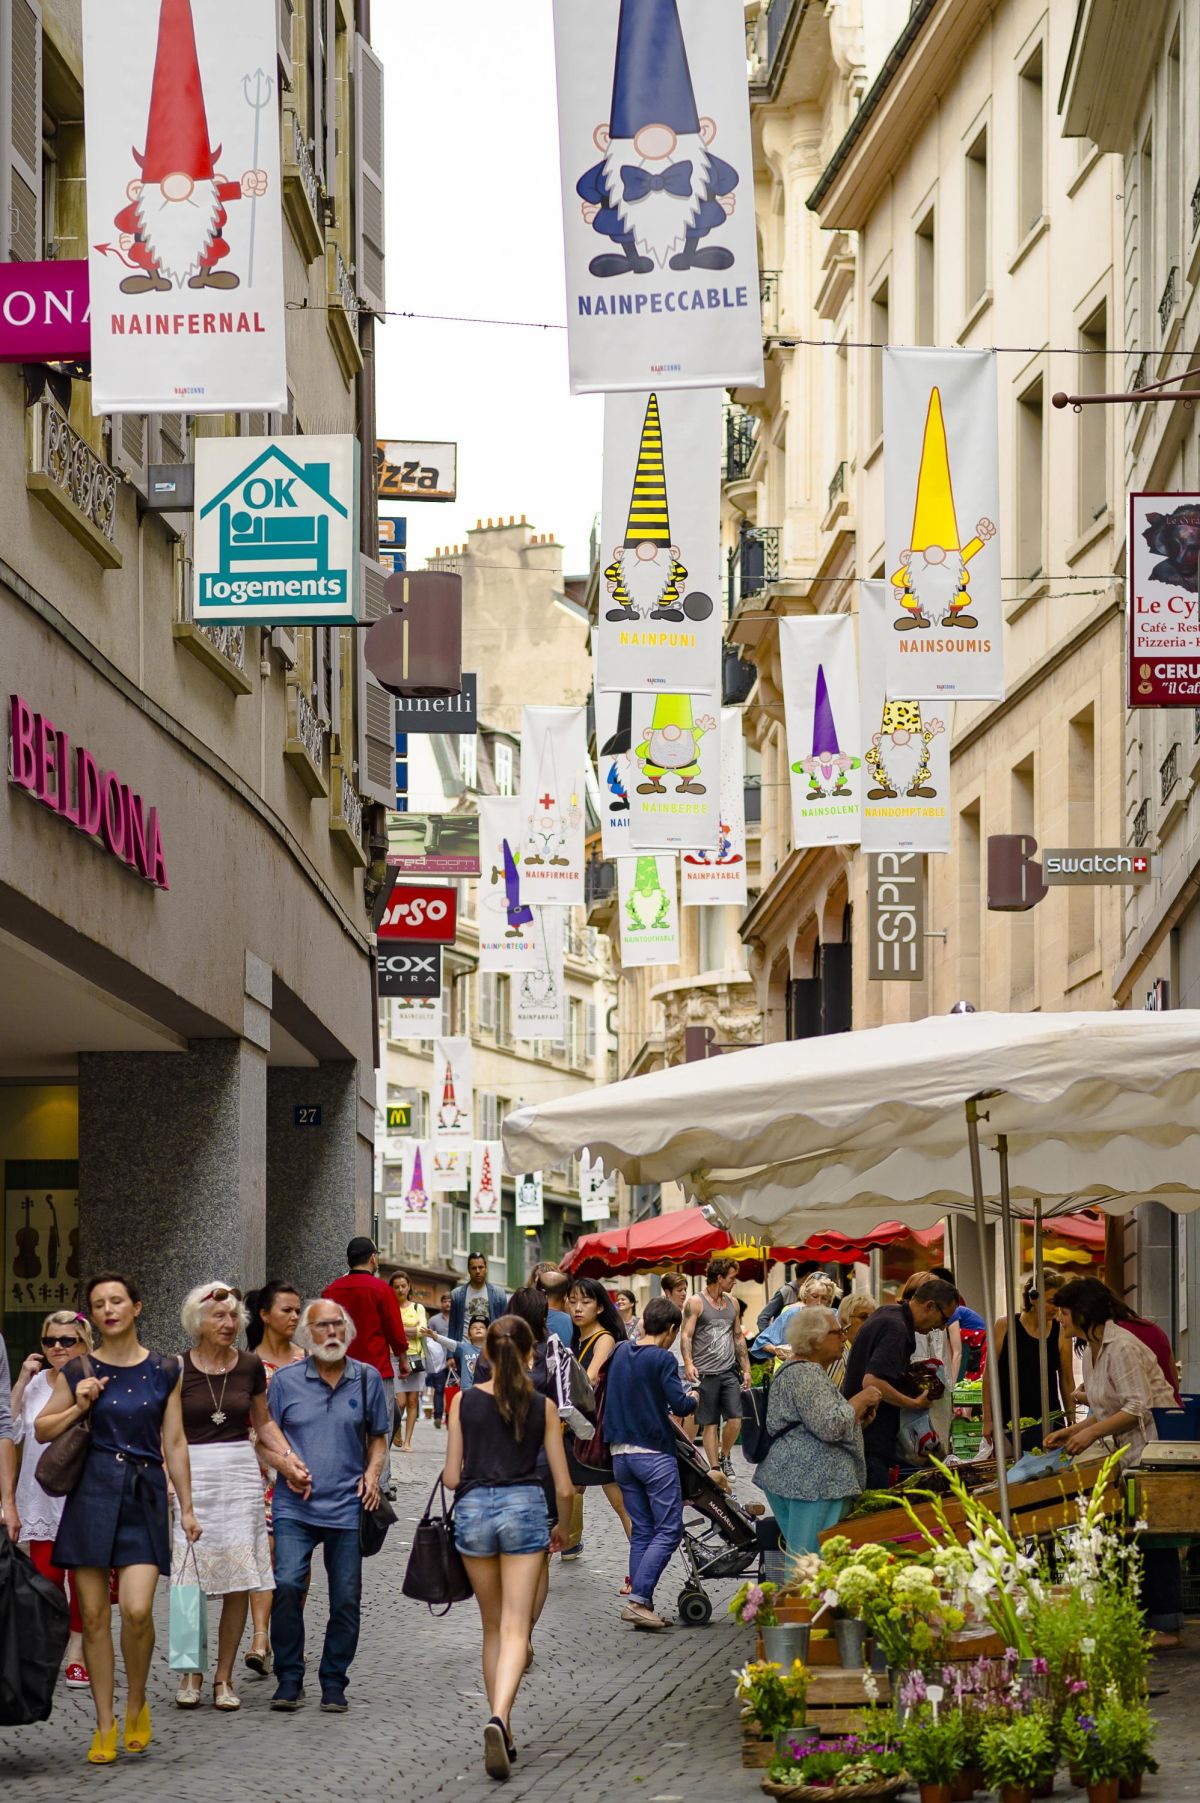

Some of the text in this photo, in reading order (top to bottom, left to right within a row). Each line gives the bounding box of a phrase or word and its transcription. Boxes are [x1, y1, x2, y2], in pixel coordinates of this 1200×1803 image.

[578, 286, 748, 316] NAINPECCABLE
[111, 312, 265, 335] NAINFERNAL
[242, 478, 298, 509] OK
[205, 576, 342, 604] logements
[1136, 597, 1161, 614] Le
[1141, 622, 1167, 633] Café
[620, 631, 696, 648] NAINPUNI
[899, 639, 992, 653] NAINSOUMIS
[1137, 636, 1186, 648] Pizzeria
[9, 694, 170, 891] BELDONA
[641, 801, 708, 814] NAINBERBE
[801, 804, 860, 817] NAINSOLENT
[865, 806, 946, 818] NAINDOMPTABLE
[610, 818, 630, 828] NAI
[1047, 854, 1131, 874] swatch
[525, 871, 579, 880] NAINFIRMIER
[687, 872, 741, 880] NAINPAYABLE
[299, 1108, 317, 1123] 27
